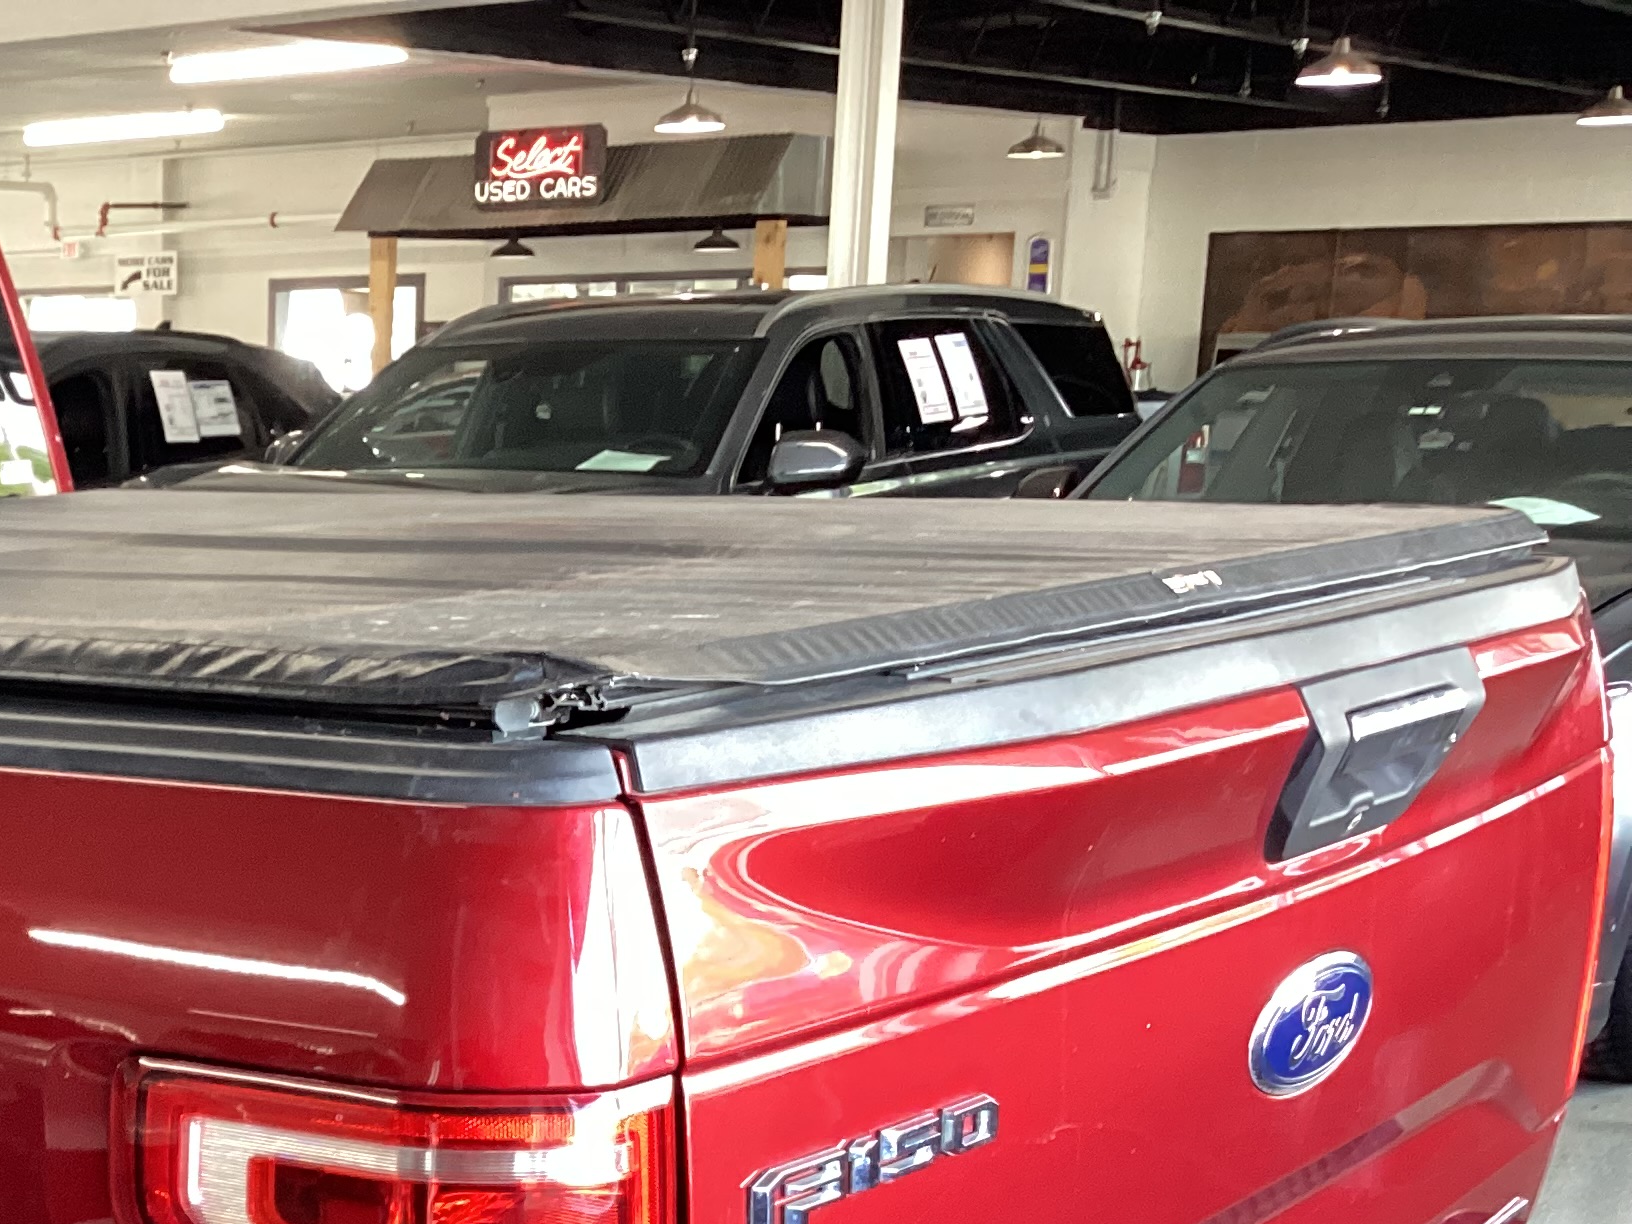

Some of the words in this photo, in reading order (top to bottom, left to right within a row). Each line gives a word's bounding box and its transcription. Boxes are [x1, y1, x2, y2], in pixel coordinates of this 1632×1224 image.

[491, 135, 581, 179] Select
[474, 179, 531, 203] USED
[539, 175, 598, 199] CARS
[143, 279, 173, 290] SALE
